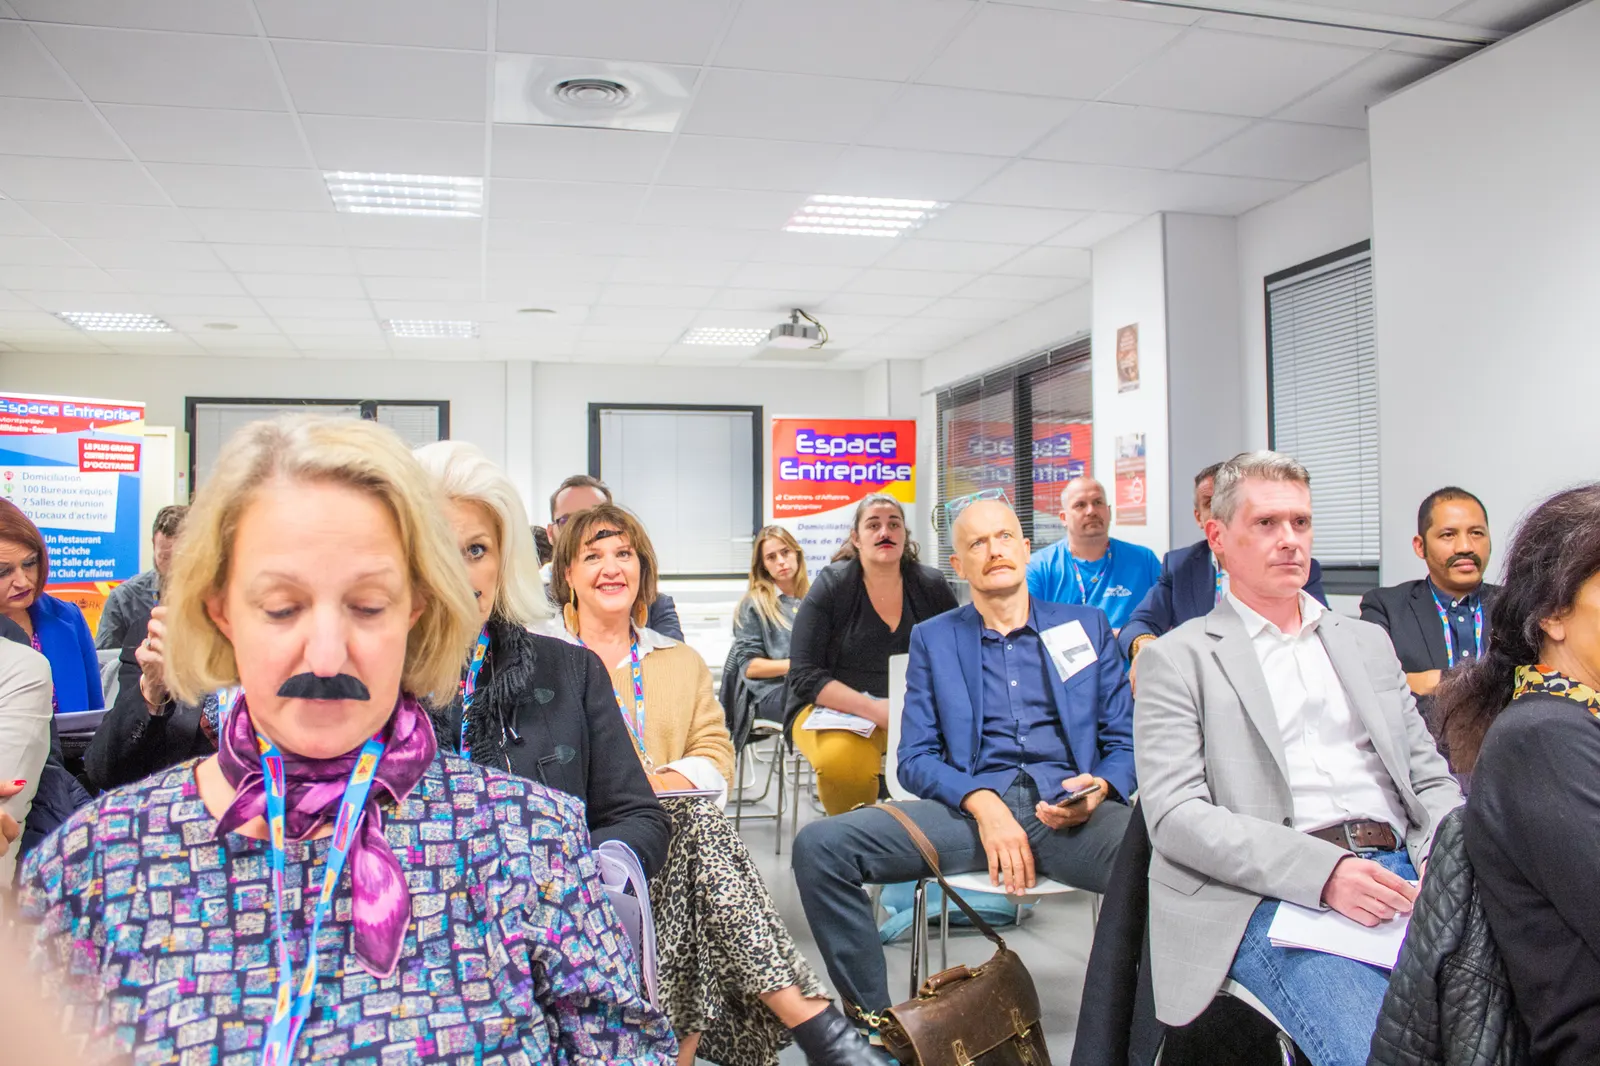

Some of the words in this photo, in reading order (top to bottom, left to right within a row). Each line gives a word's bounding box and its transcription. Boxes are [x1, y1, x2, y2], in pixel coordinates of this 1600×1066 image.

[62, 404, 140, 421] Entreprise
[84, 442, 92, 450] LE
[93, 443, 109, 451] PLUS
[110, 444, 135, 453] GRAND
[796, 434, 897, 457] Espace
[83, 461, 135, 471] D'OCCITANIE
[22, 472, 81, 482] Domiciliation
[780, 461, 911, 483] Entreprise
[23, 485, 39, 493] 100
[41, 485, 76, 494] Bureaux
[79, 486, 113, 496] équipés
[30, 498, 55, 506] Salles
[57, 499, 68, 507] de
[70, 499, 104, 508] réunion
[35, 511, 65, 519] Locaux
[69, 511, 107, 520] d'activité
[45, 535, 56, 544] Un
[58, 535, 101, 544] Restaurant
[820, 537, 832, 545] de
[62, 546, 90, 555] Crèche
[62, 557, 82, 566] Salle
[83, 557, 94, 567] de
[95, 558, 115, 568] sport
[57, 568, 76, 578] Club
[77, 568, 113, 578] d'affaires
